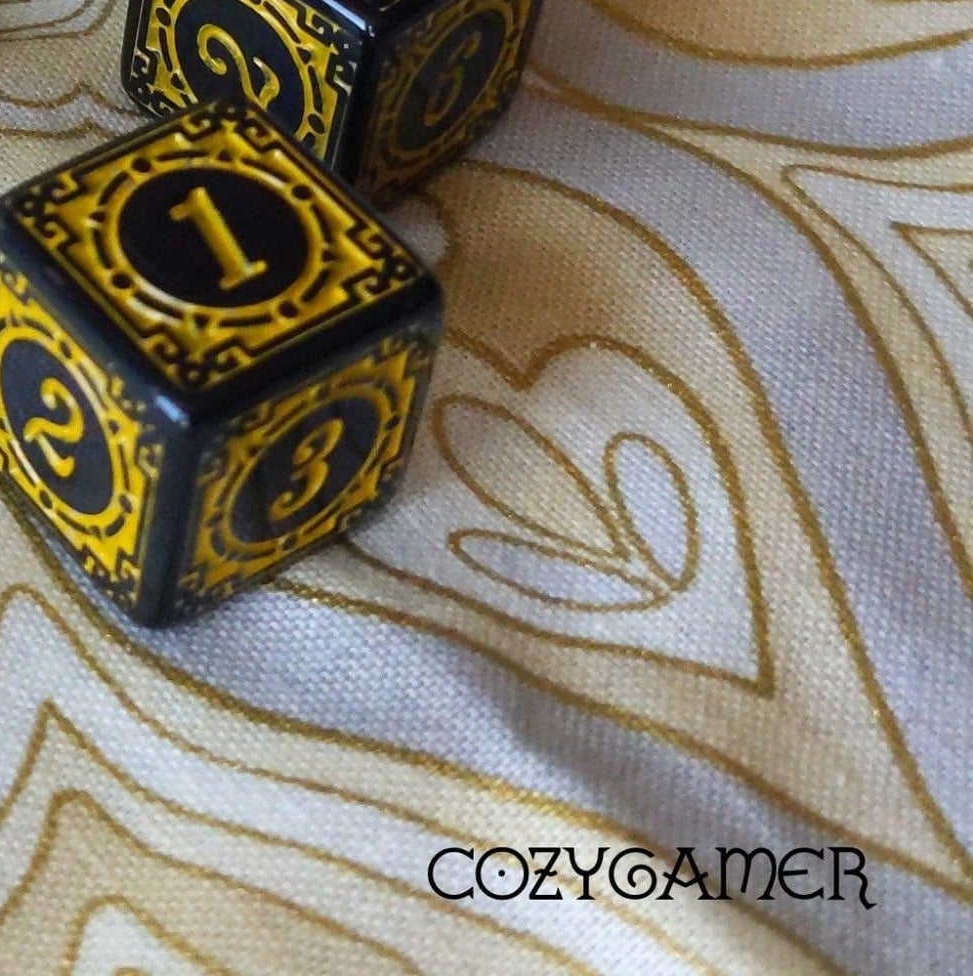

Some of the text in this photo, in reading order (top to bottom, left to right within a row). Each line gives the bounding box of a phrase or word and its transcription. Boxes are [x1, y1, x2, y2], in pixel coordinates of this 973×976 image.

[196, 23, 281, 111] 2
[169, 185, 269, 290] 1
[22, 377, 85, 478] 2
[271, 418, 345, 522] 3
